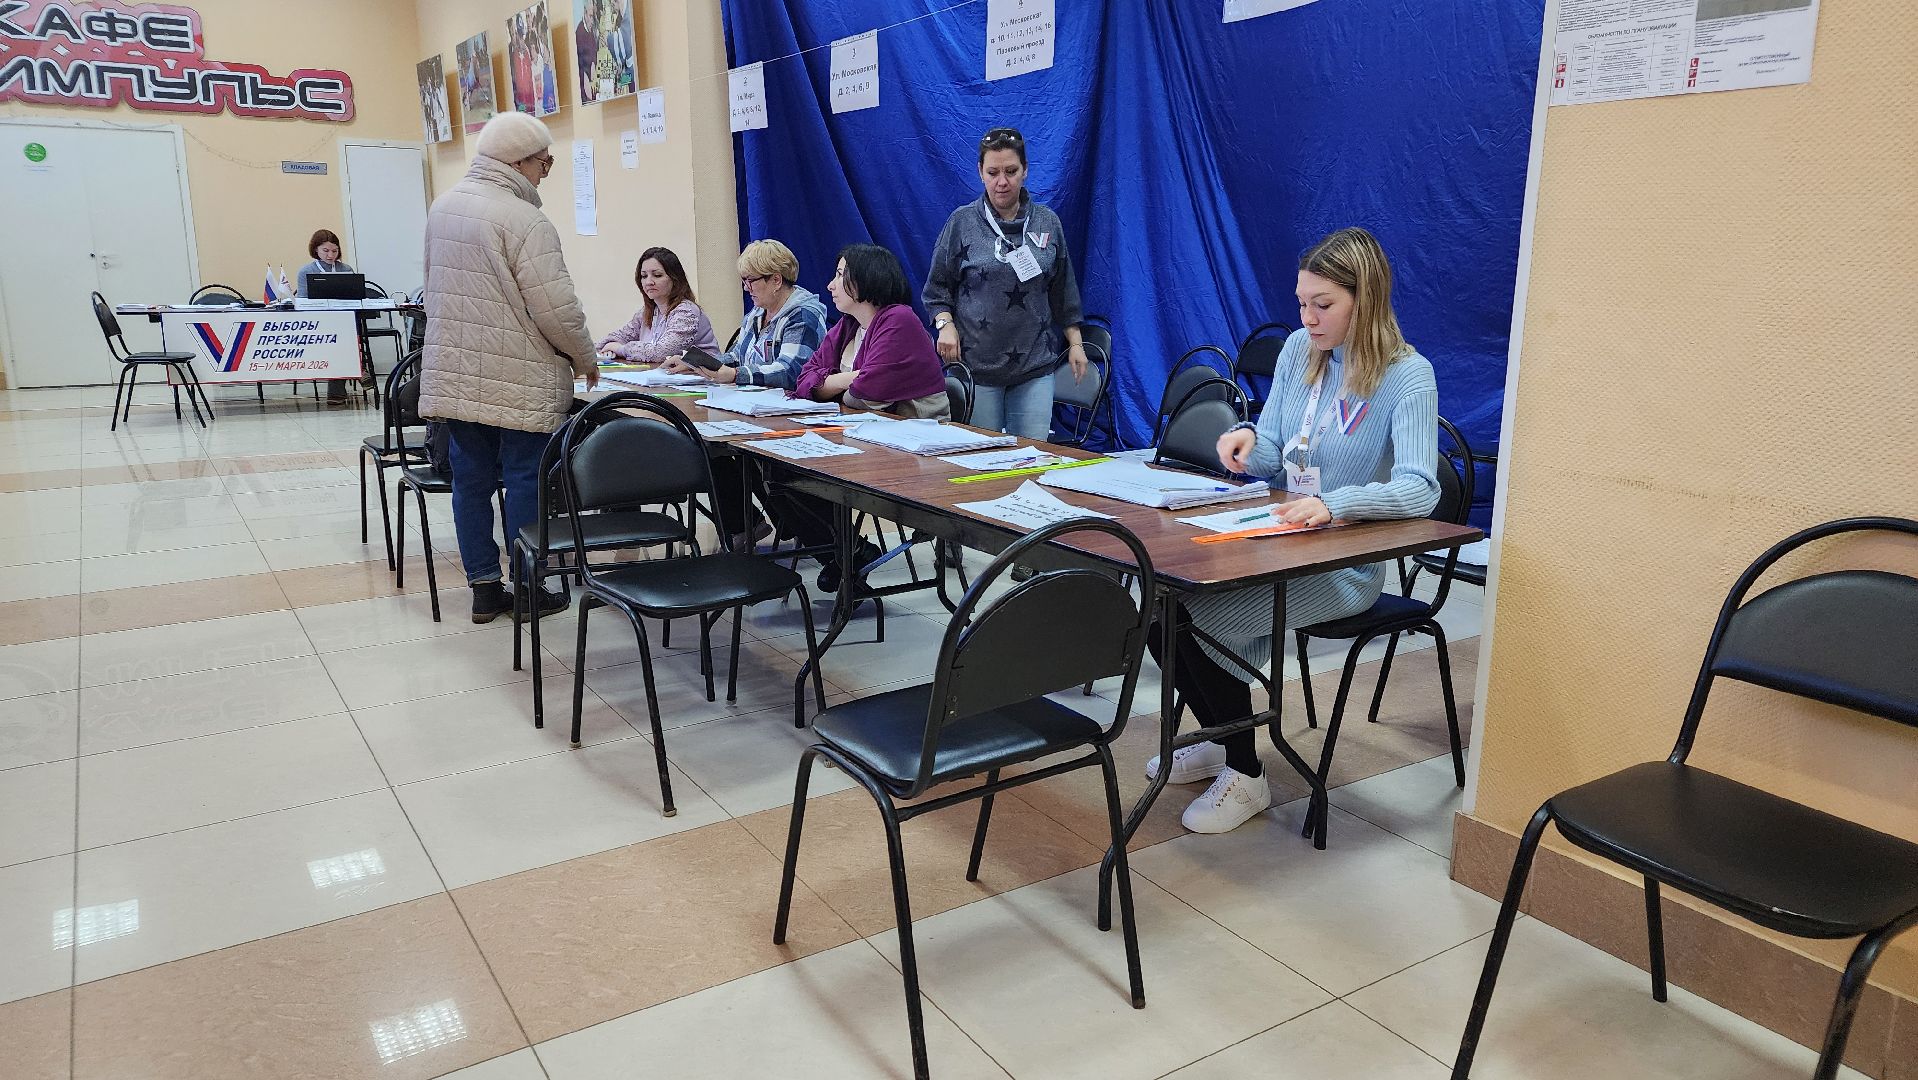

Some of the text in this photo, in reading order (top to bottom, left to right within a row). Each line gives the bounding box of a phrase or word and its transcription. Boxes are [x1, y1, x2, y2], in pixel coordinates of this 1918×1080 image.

[1009, 11, 1042, 26] Московская
[0, 3, 193, 50] КАФЕ
[841, 63, 877, 79] Московская
[0, 58, 343, 111] ИМПУЛЬС
[262, 320, 320, 332] ВЫБОРЫ
[257, 334, 337, 346] ПРЕЗИДЕНТА
[252, 349, 304, 360] РОССИИ
[275, 361, 306, 371] МАРТА
[307, 360, 329, 370] 2024
